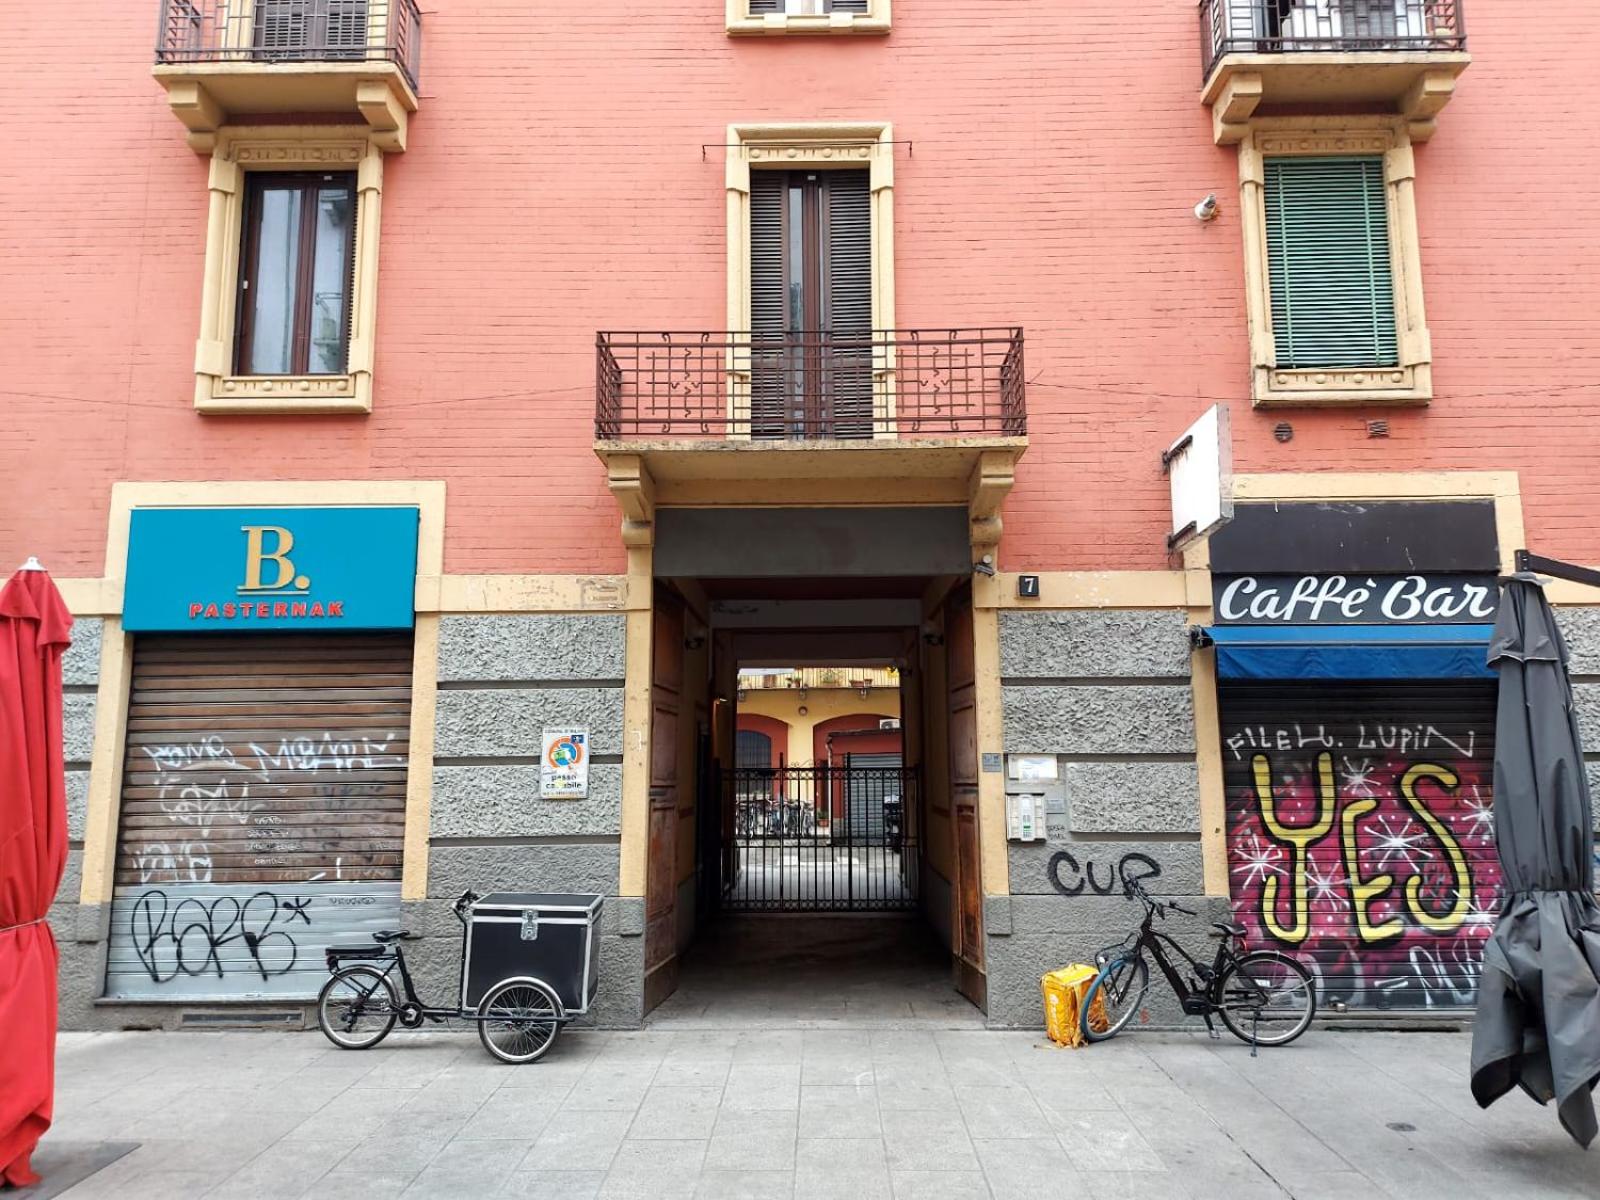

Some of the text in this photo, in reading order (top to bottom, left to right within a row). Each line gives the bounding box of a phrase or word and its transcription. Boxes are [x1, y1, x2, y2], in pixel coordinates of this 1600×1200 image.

[237, 525, 311, 591] B.
[1024, 577, 1035, 593] 7
[1218, 575, 1495, 621] Caffè Bar
[188, 600, 345, 619] PASTERNAK
[1250, 750, 1474, 944] YES
